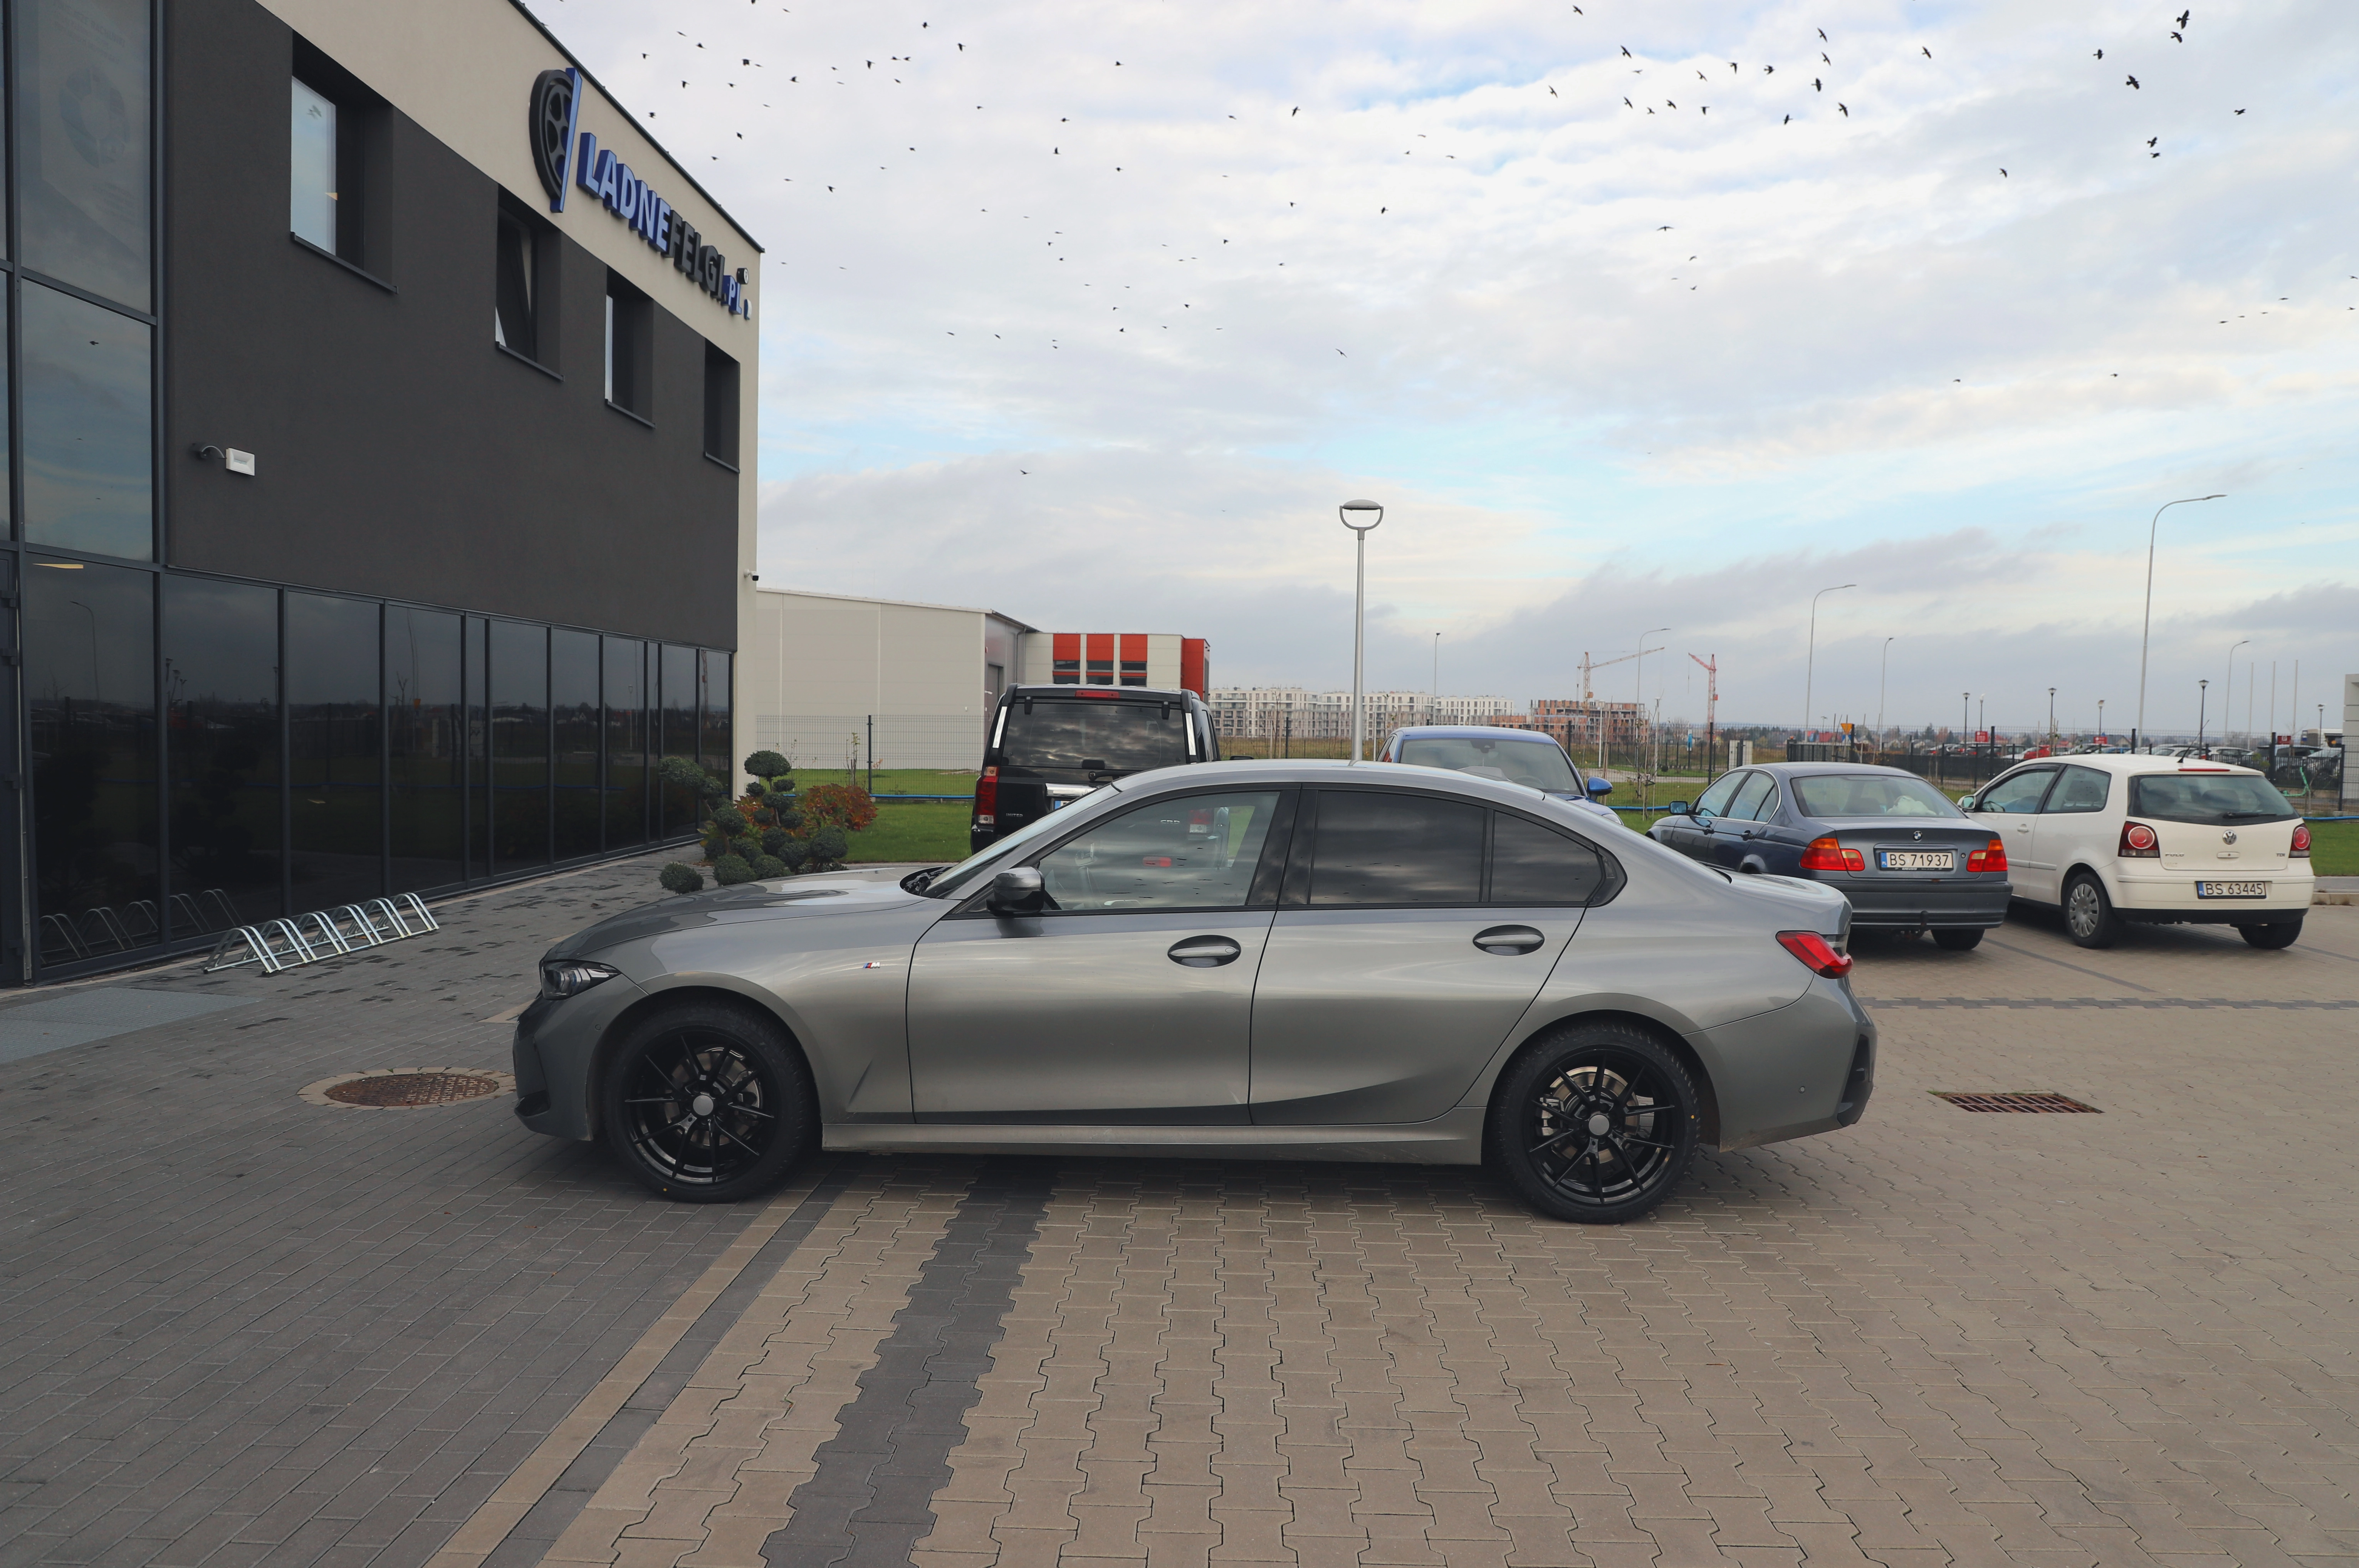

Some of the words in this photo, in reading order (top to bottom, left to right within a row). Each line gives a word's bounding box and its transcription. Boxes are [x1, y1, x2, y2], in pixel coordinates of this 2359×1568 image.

[1890, 854, 1906, 866] BS
[1911, 854, 1949, 866] 71937
[2206, 884, 2223, 895] BS
[2228, 883, 2263, 895] 63445
